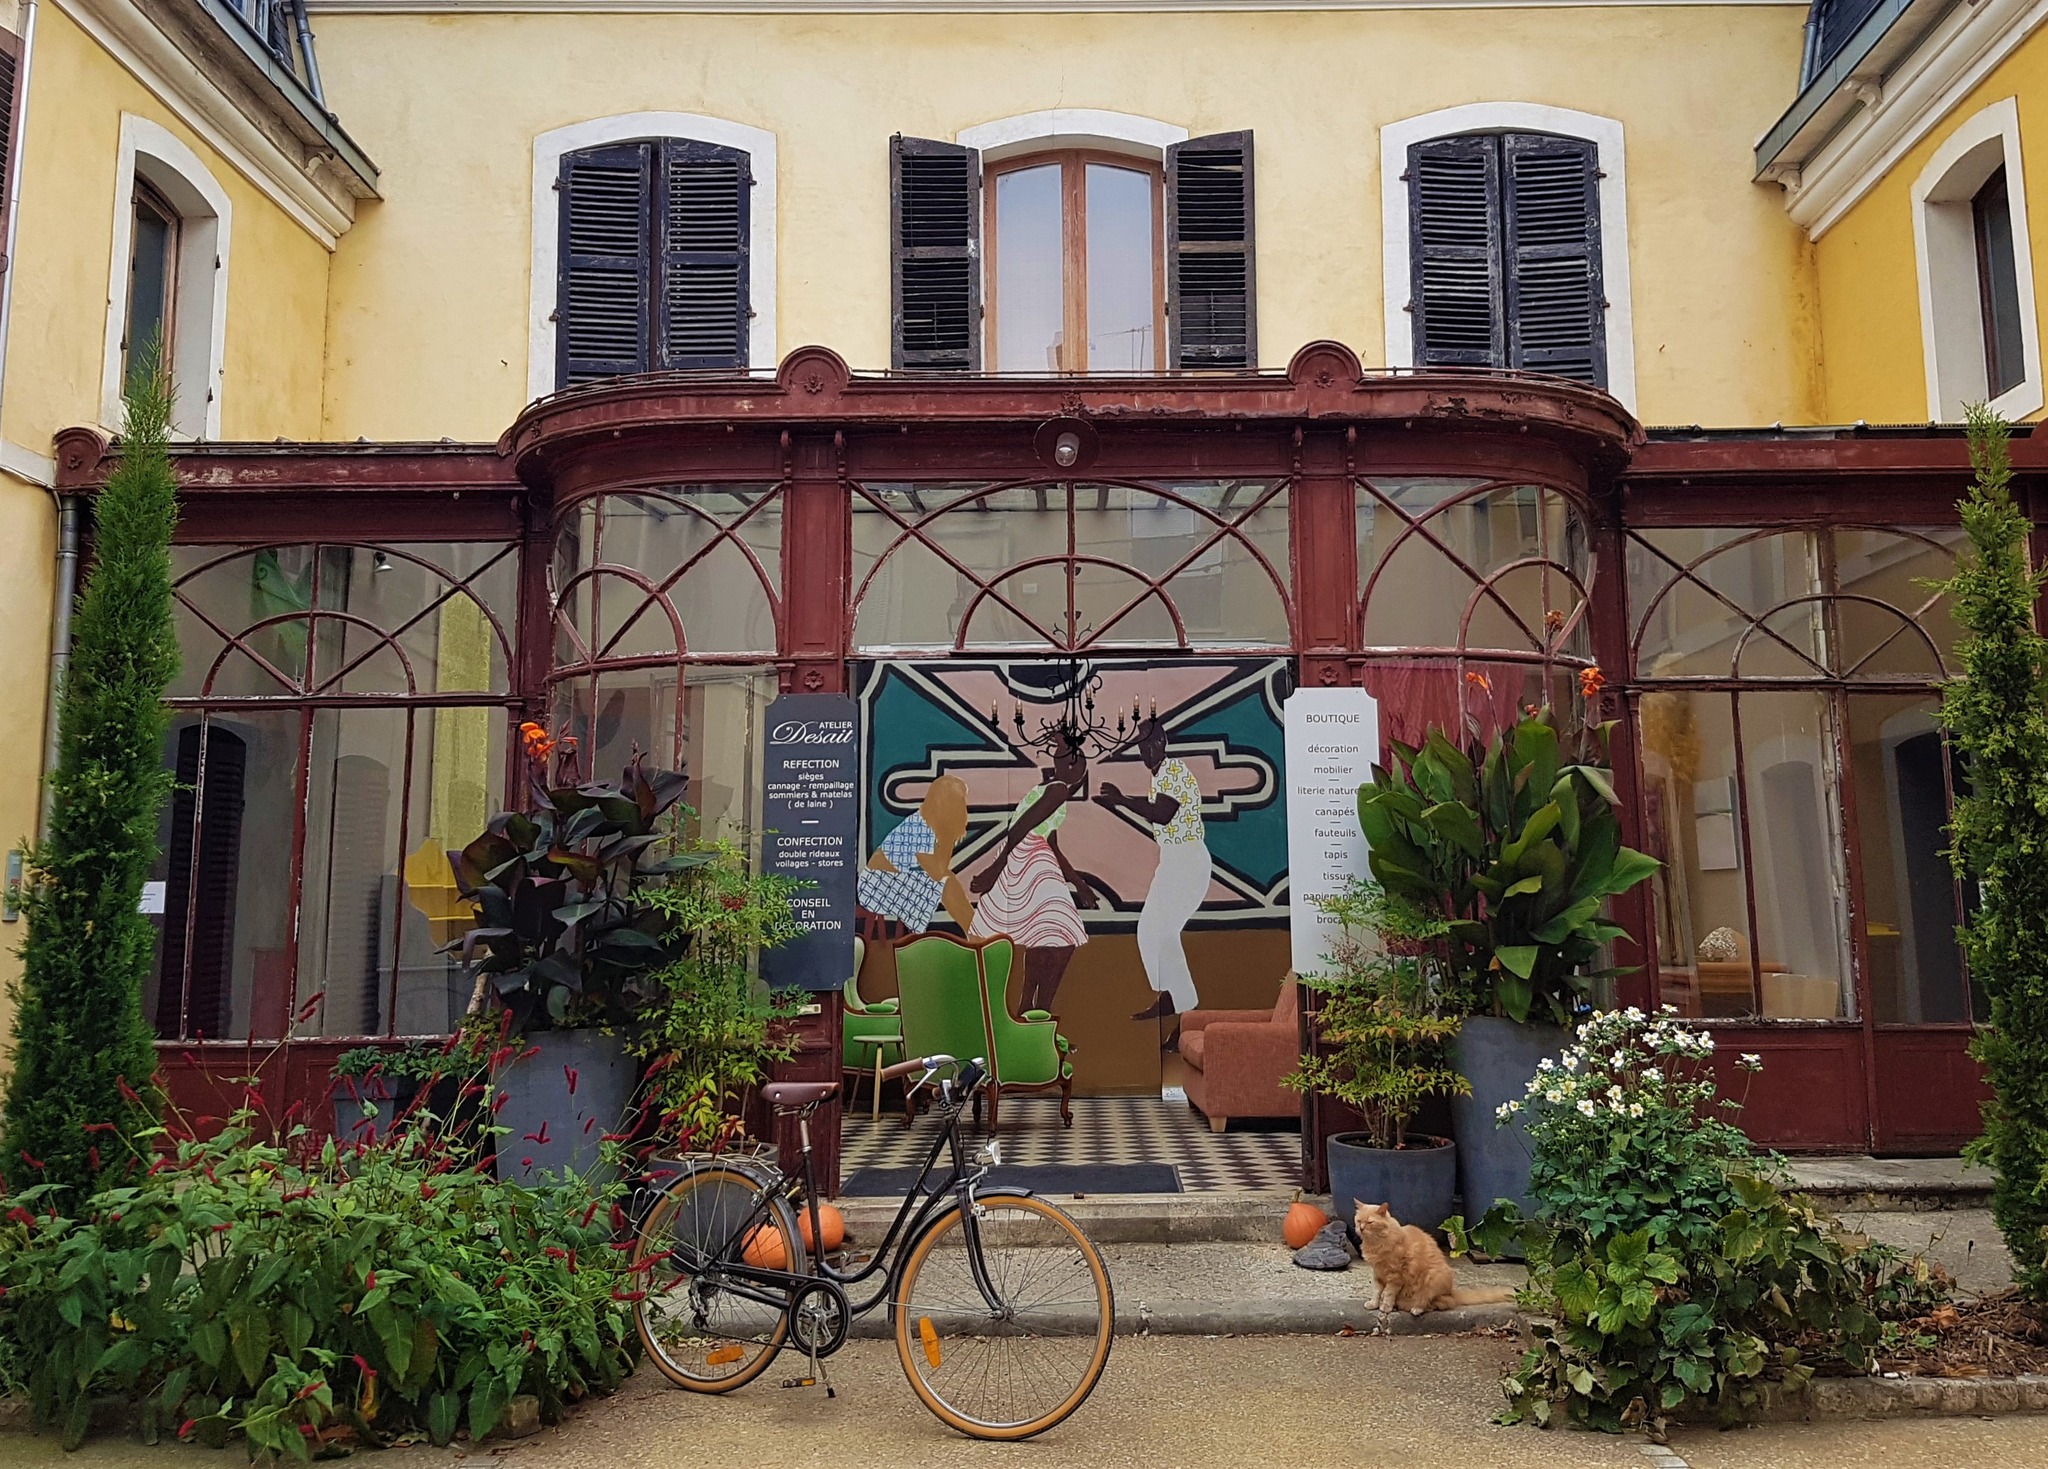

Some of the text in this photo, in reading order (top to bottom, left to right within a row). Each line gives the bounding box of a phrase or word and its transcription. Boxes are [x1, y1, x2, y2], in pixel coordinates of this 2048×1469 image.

[1306, 714, 1360, 724] BOUTIQUE
[819, 721, 853, 729] ATELIER
[769, 720, 854, 745] Desait
[1307, 743, 1359, 753] décoration
[783, 759, 840, 769] REFECTION
[1313, 765, 1353, 774] mobilier
[798, 772, 824, 782] sièges
[767, 783, 800, 791] cannage
[808, 782, 854, 790] rempaillage
[1297, 786, 1325, 795] literie
[820, 790, 853, 798] matelas
[807, 800, 827, 808] laine
[1315, 806, 1355, 817] canapés
[1314, 828, 1357, 837] fauteuils
[777, 836, 843, 847] CONFECTION
[778, 850, 840, 858] double rideaux
[1324, 850, 1348, 859] tapis
[775, 859, 809, 869] voilages
[818, 859, 844, 867] stores
[786, 898, 831, 908] CONSEIL
[801, 909, 815, 919] EN
